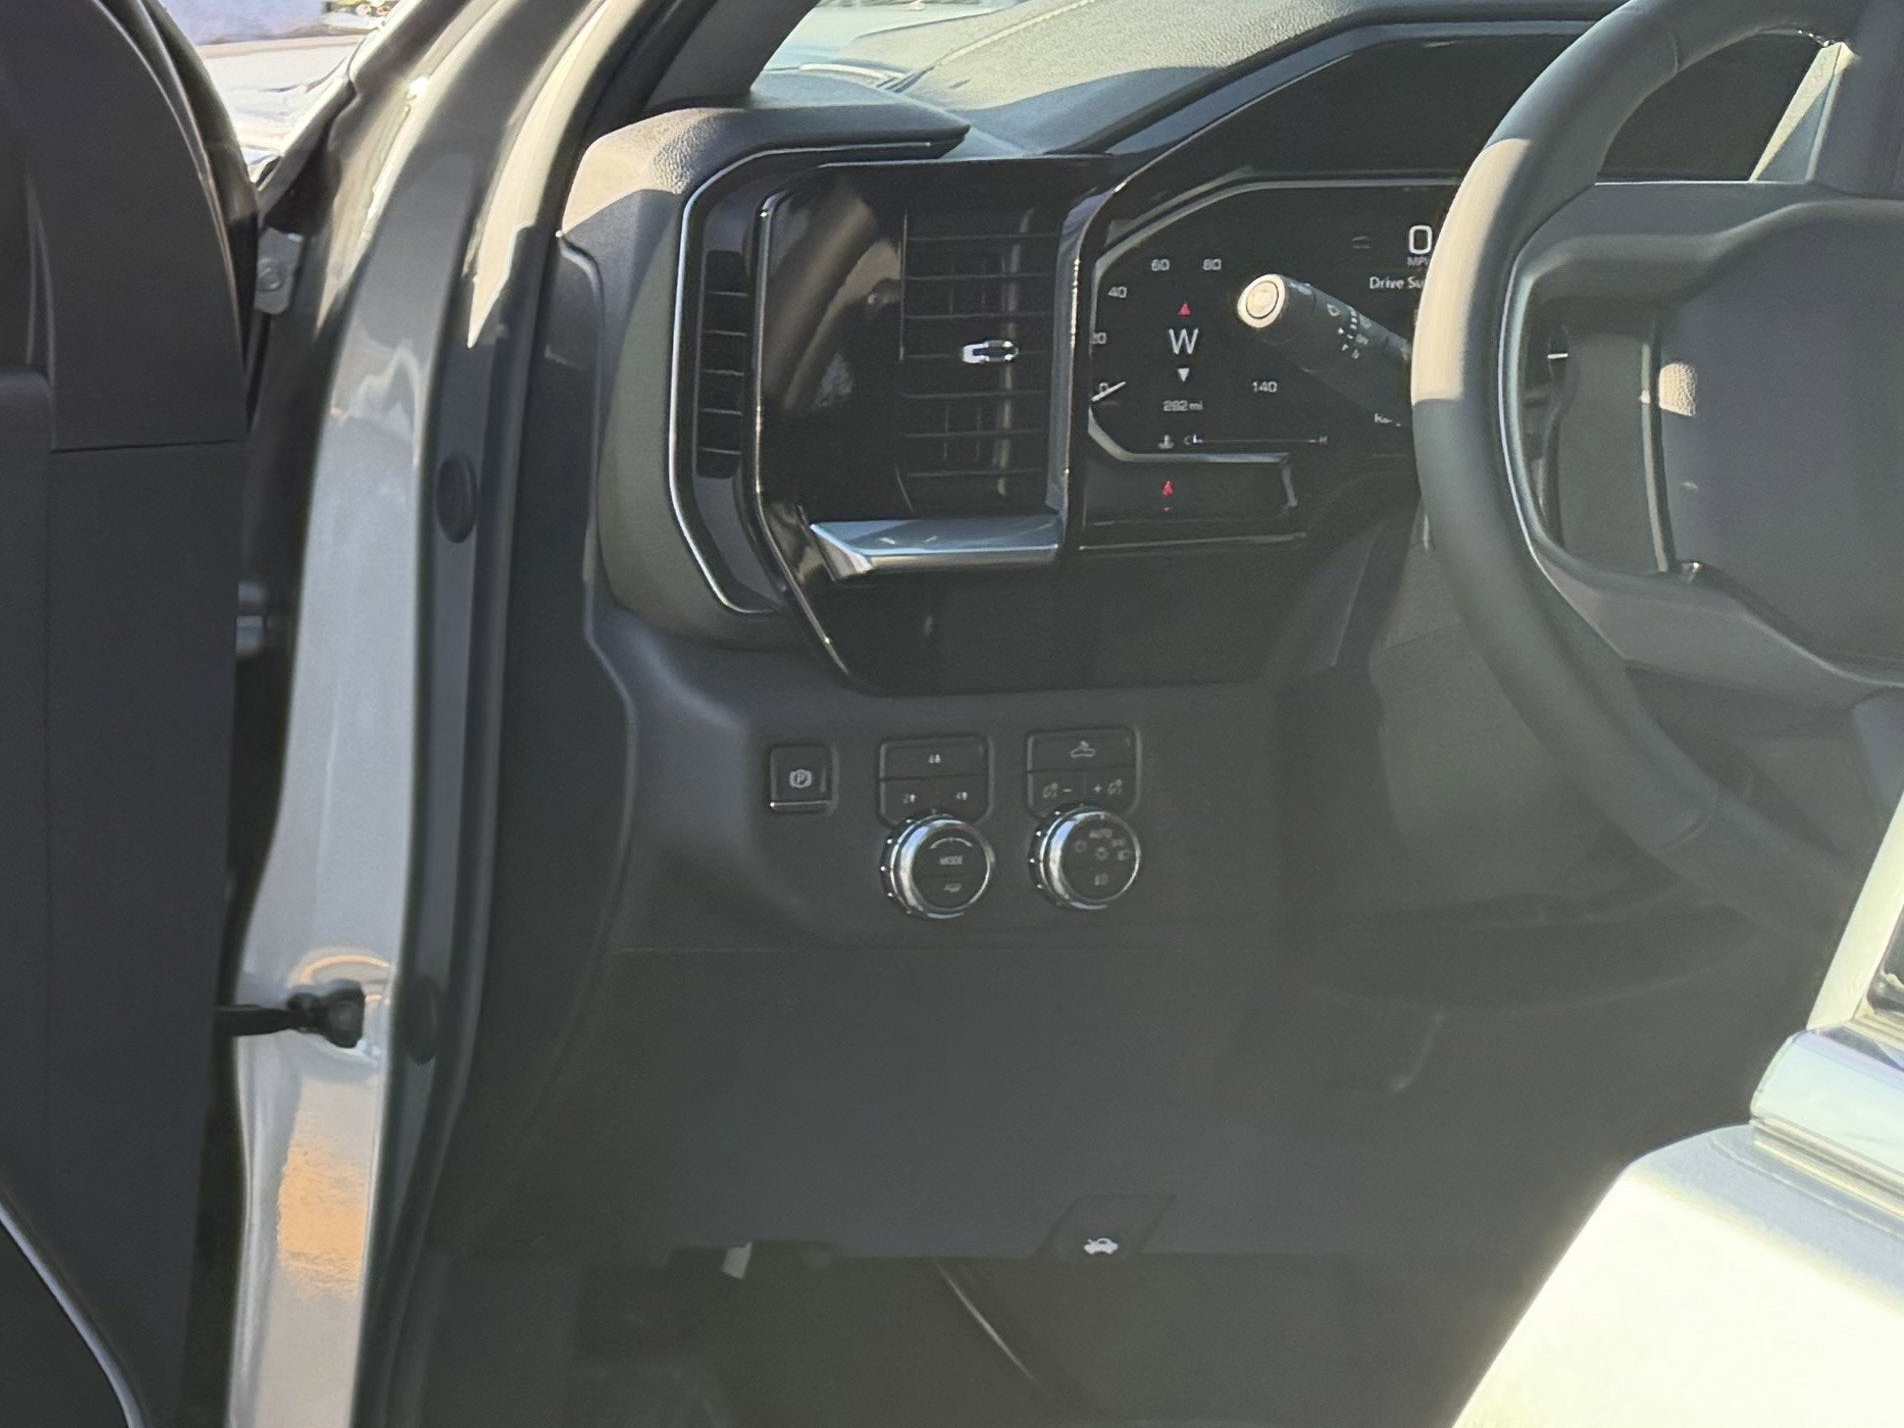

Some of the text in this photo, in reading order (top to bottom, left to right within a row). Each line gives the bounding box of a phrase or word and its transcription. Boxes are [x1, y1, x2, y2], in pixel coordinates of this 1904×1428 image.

[1408, 224, 1434, 255] 0
[1150, 259, 1171, 271] 60
[1202, 258, 1223, 271] 80
[1107, 286, 1128, 299] 40
[1168, 328, 1200, 355] W
[1252, 381, 1278, 393] 140
